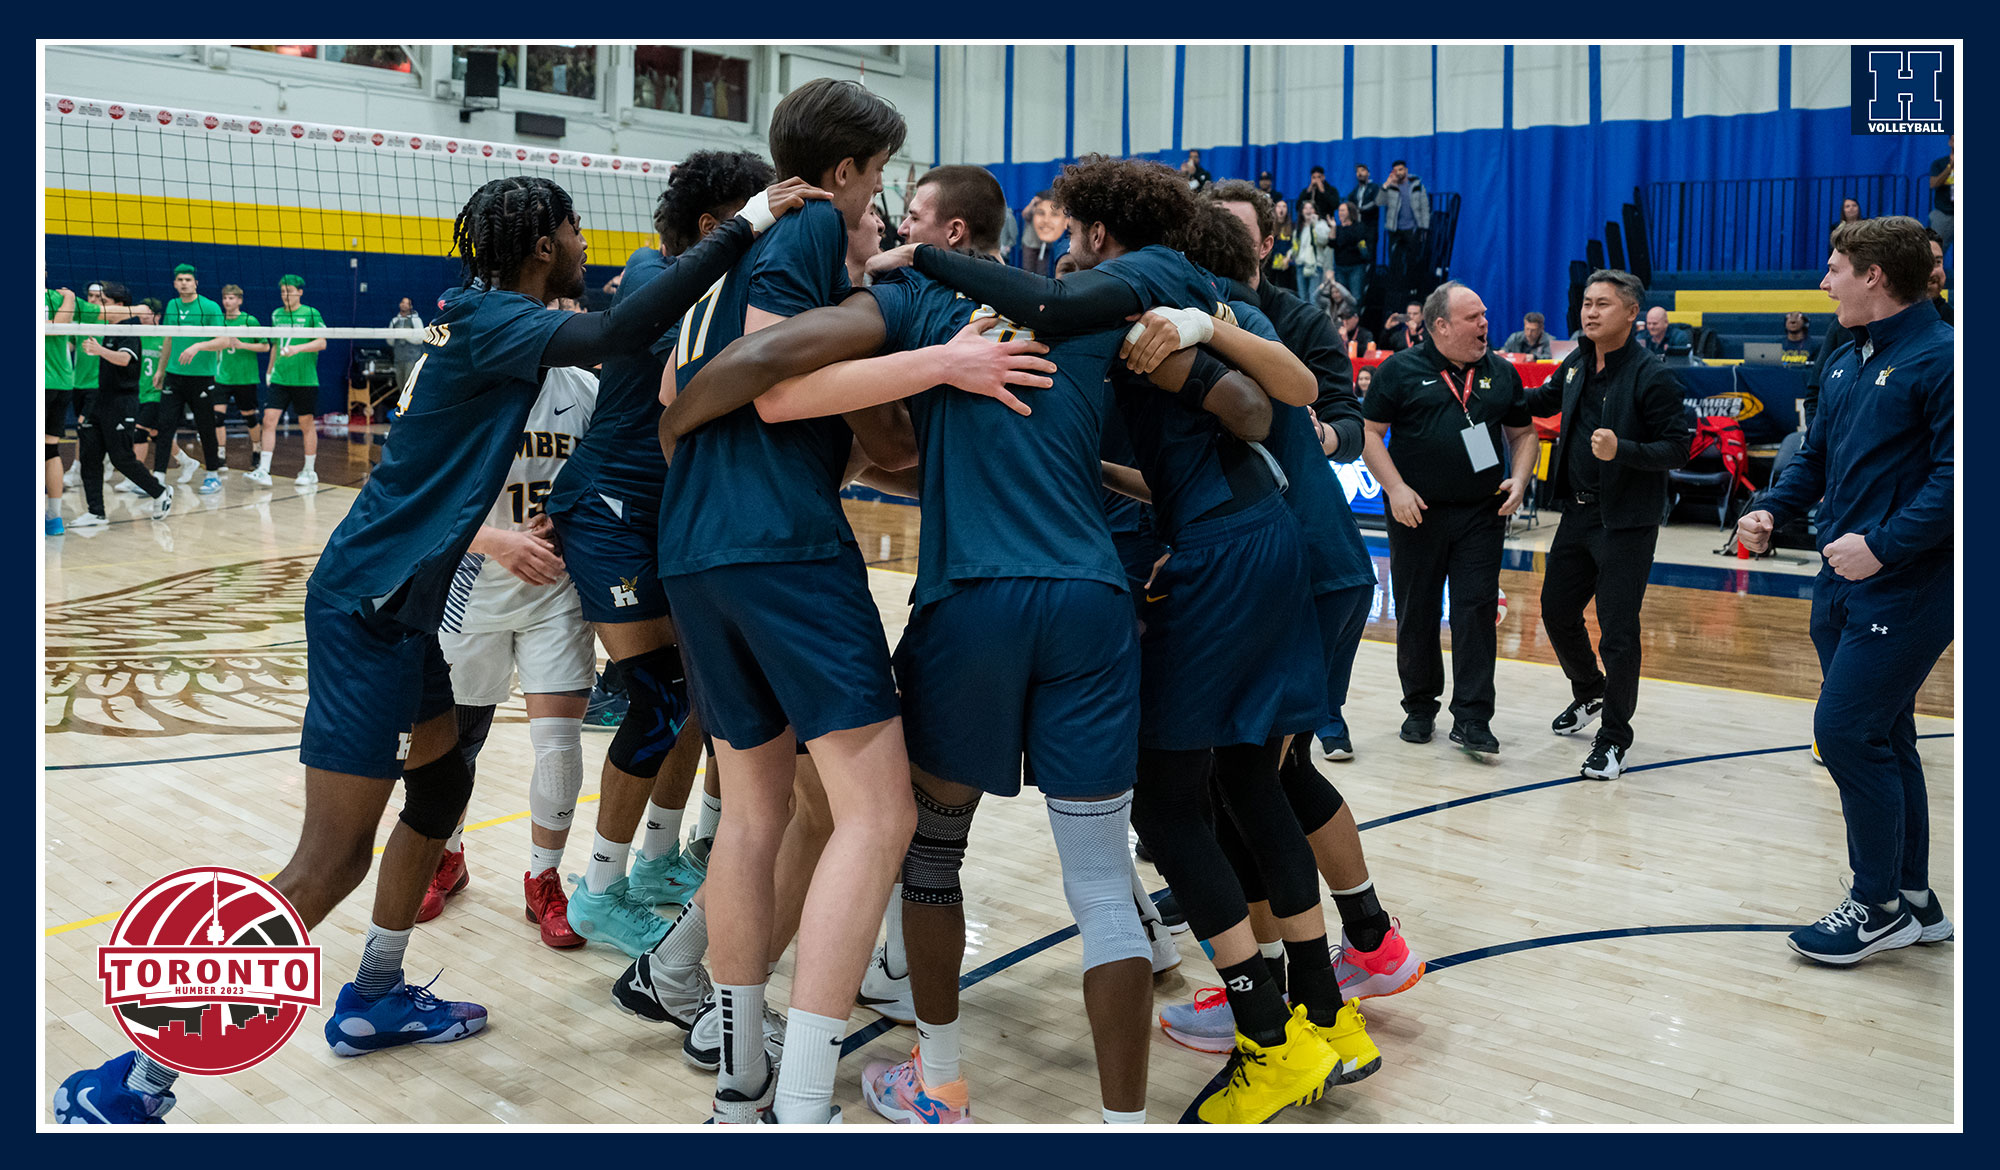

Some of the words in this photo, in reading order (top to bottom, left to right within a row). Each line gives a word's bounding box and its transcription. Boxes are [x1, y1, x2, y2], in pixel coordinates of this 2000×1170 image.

[677, 272, 727, 370] 17
[144, 357, 153, 377] 3
[1682, 398, 1742, 409] HUMBER
[1695, 407, 1741, 418] AWKS
[514, 431, 582, 461] MBE
[507, 481, 553, 524] 15
